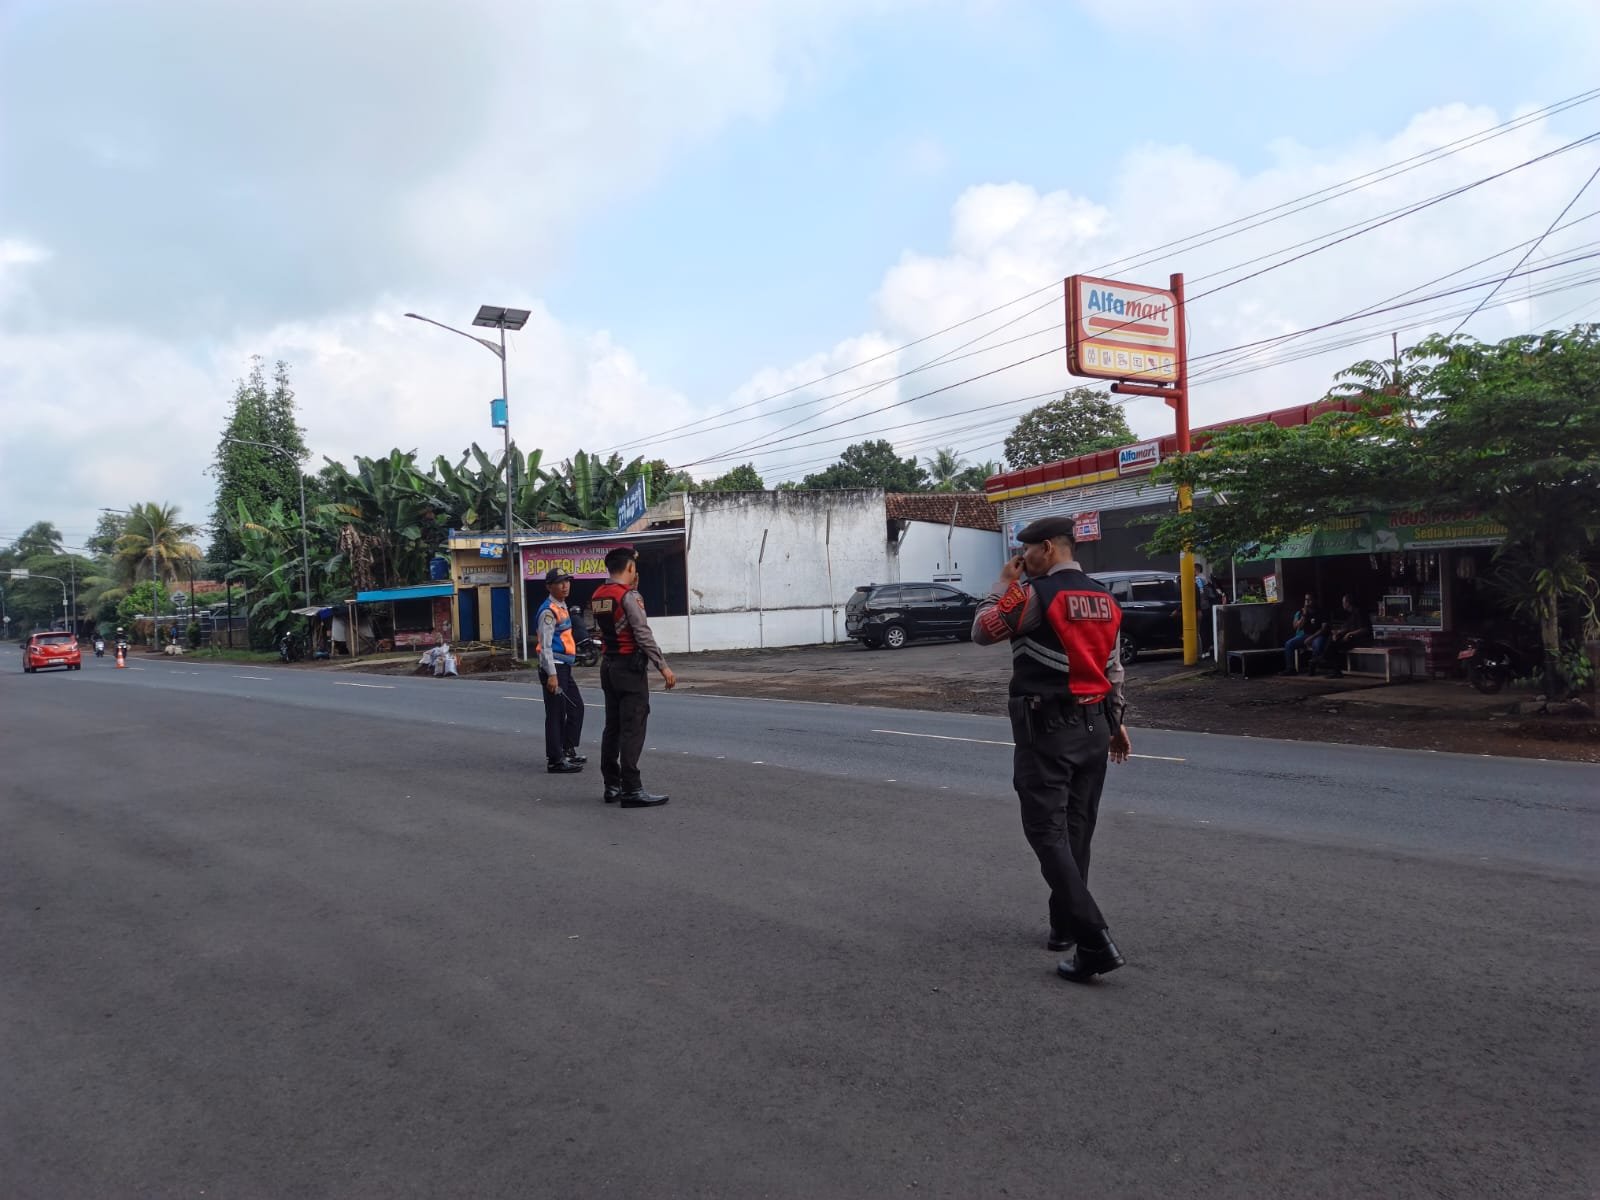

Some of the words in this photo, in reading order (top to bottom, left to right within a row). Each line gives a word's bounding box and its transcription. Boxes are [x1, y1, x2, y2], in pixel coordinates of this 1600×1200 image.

[1088, 289, 1168, 322] Alfamart
[1120, 446, 1156, 463] Alfamart
[1414, 527, 1443, 540] Sedia
[1445, 525, 1473, 539] Ayam
[527, 559, 535, 576] 3
[536, 559, 575, 575] PUTRI
[576, 558, 607, 575] JAYA
[1069, 595, 1112, 619] POLISI
